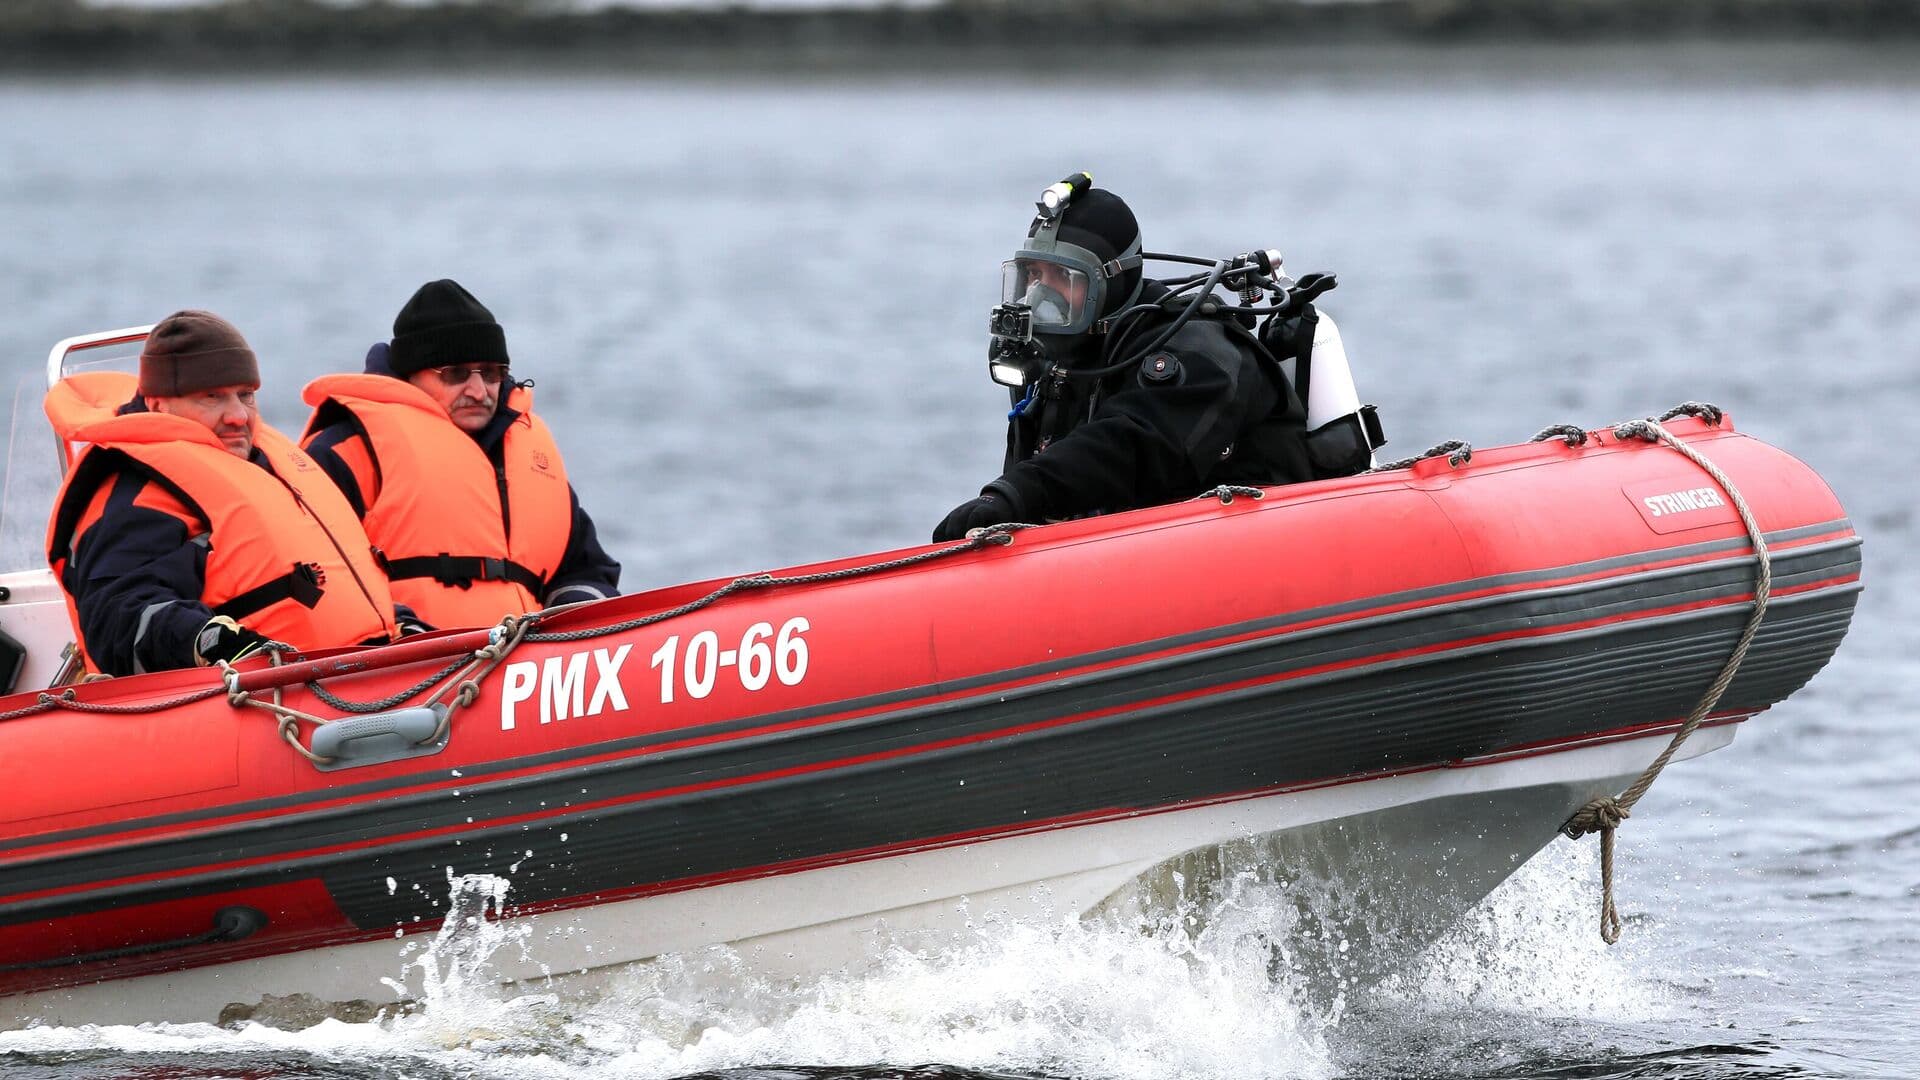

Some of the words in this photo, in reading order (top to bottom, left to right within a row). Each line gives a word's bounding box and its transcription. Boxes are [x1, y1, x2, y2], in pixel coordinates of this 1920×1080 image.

[1643, 487, 1725, 517] STRINGER
[501, 643, 633, 730] PMX
[651, 616, 810, 704] 10-66
